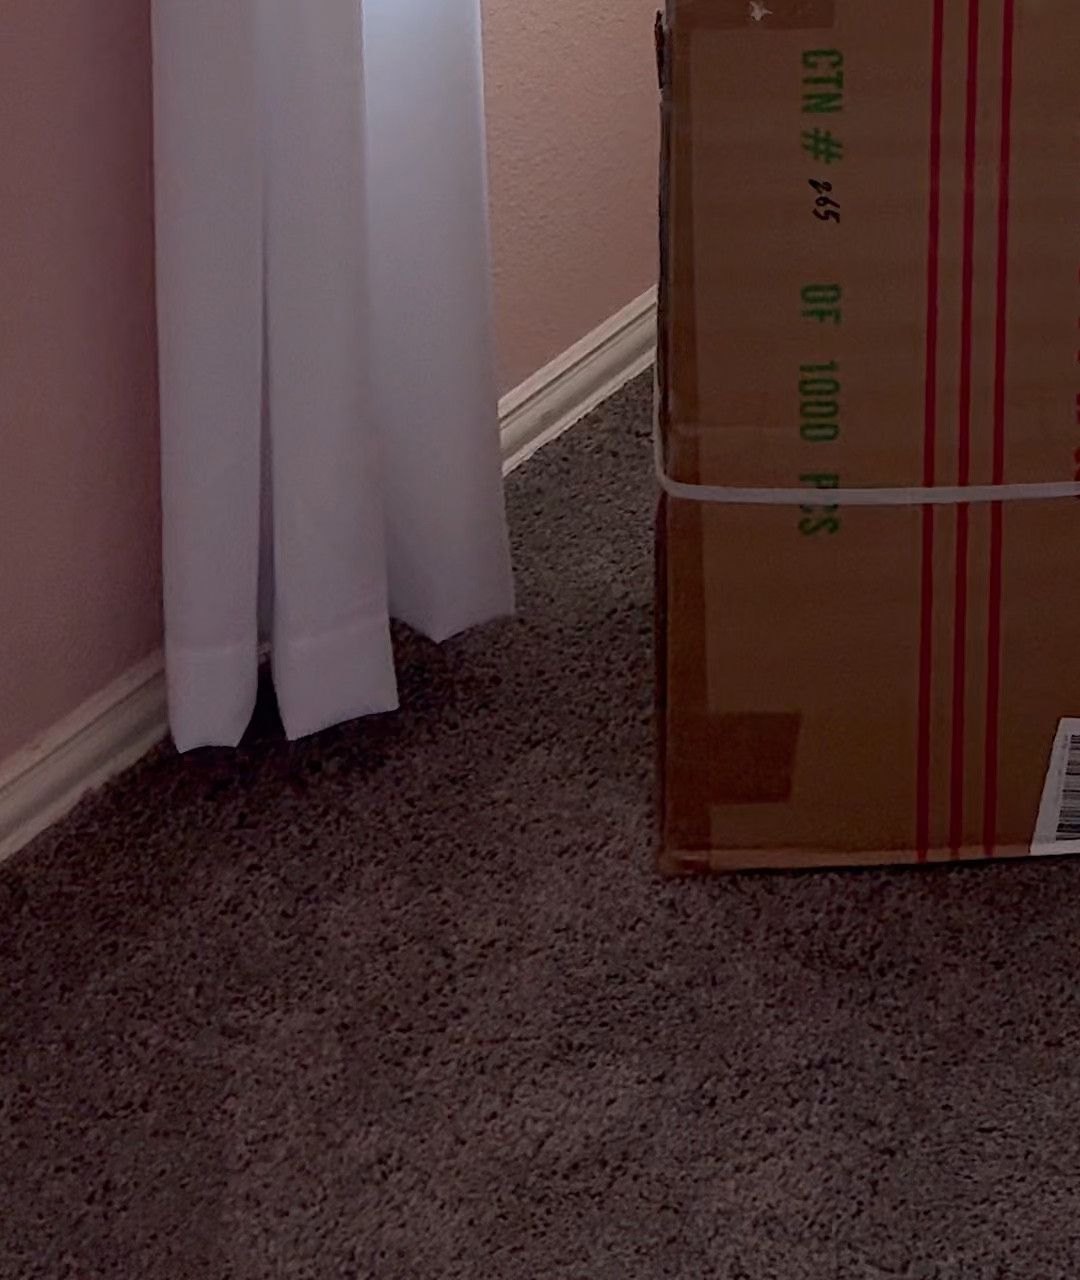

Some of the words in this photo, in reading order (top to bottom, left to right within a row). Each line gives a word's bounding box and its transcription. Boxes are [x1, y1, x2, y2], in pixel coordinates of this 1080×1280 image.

[801, 49, 844, 114] CTN
[800, 127, 844, 165] #
[799, 283, 843, 326] OF
[798, 359, 842, 444] 1000
